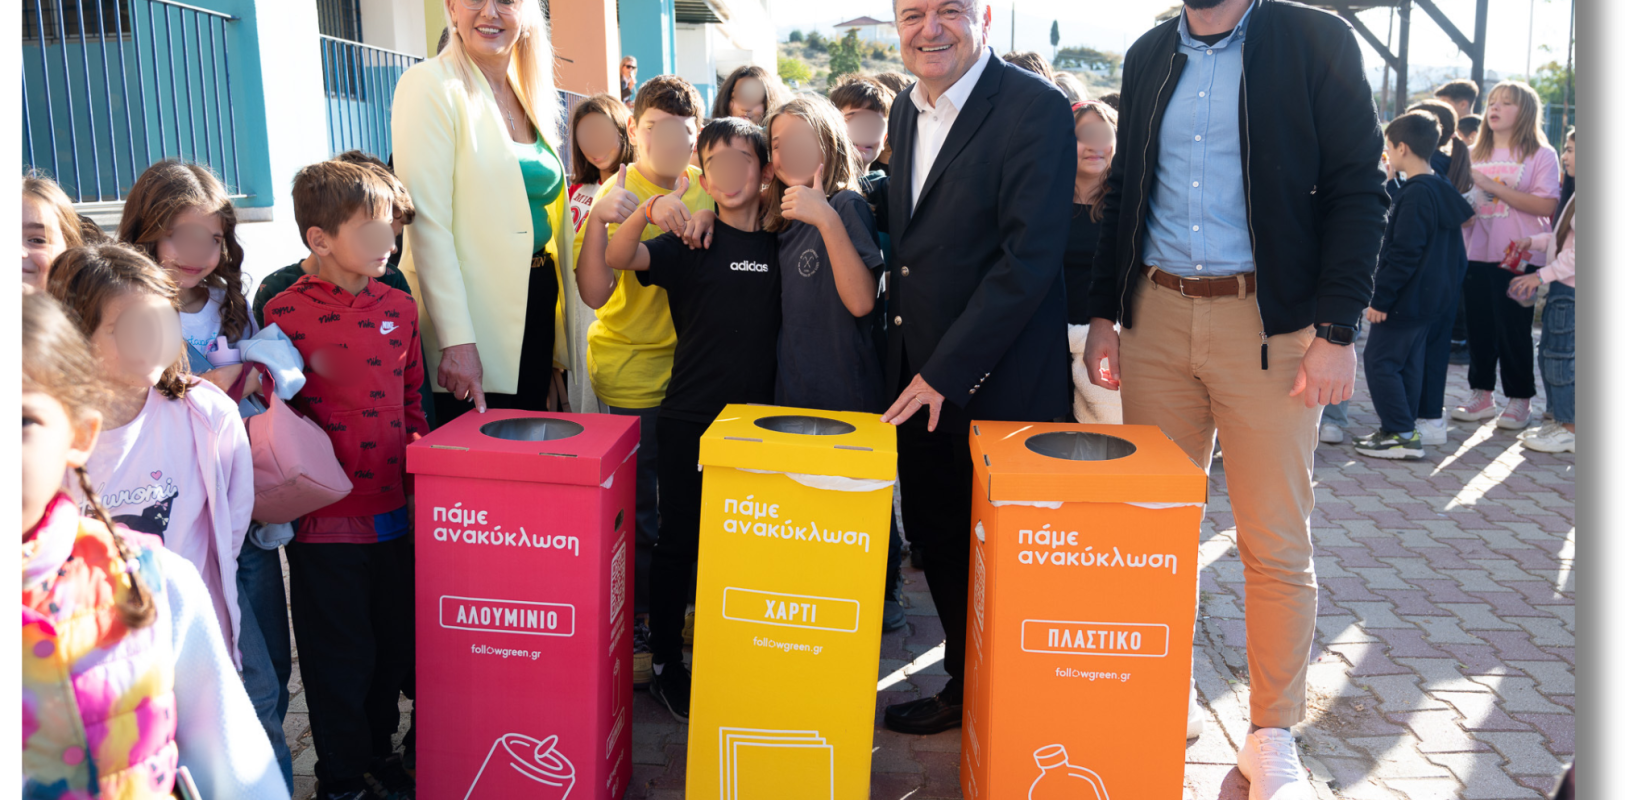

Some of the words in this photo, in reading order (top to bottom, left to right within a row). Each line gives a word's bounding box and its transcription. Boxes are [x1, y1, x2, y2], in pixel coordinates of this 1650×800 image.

[730, 260, 768, 272] adidas
[382, 321, 394, 329] NIKE
[433, 502, 488, 527] πάμε
[724, 494, 780, 520] πάμε
[433, 525, 580, 556] ανακύκλωση
[723, 519, 871, 553] ανακύκλωση
[1018, 523, 1079, 549] πάμε
[1018, 546, 1177, 575] ανακύκλωση
[456, 604, 558, 630] ΑΛΟΥΜΙΝΙΟ
[764, 599, 816, 623] ΧΑΡΤΙ
[753, 636, 824, 655] followgreen.gr
[1048, 628, 1142, 650] ΠΛΑΣΤΙΚΟ
[471, 643, 541, 661] followgreen.gr
[1055, 667, 1131, 683] followgreen.gr
